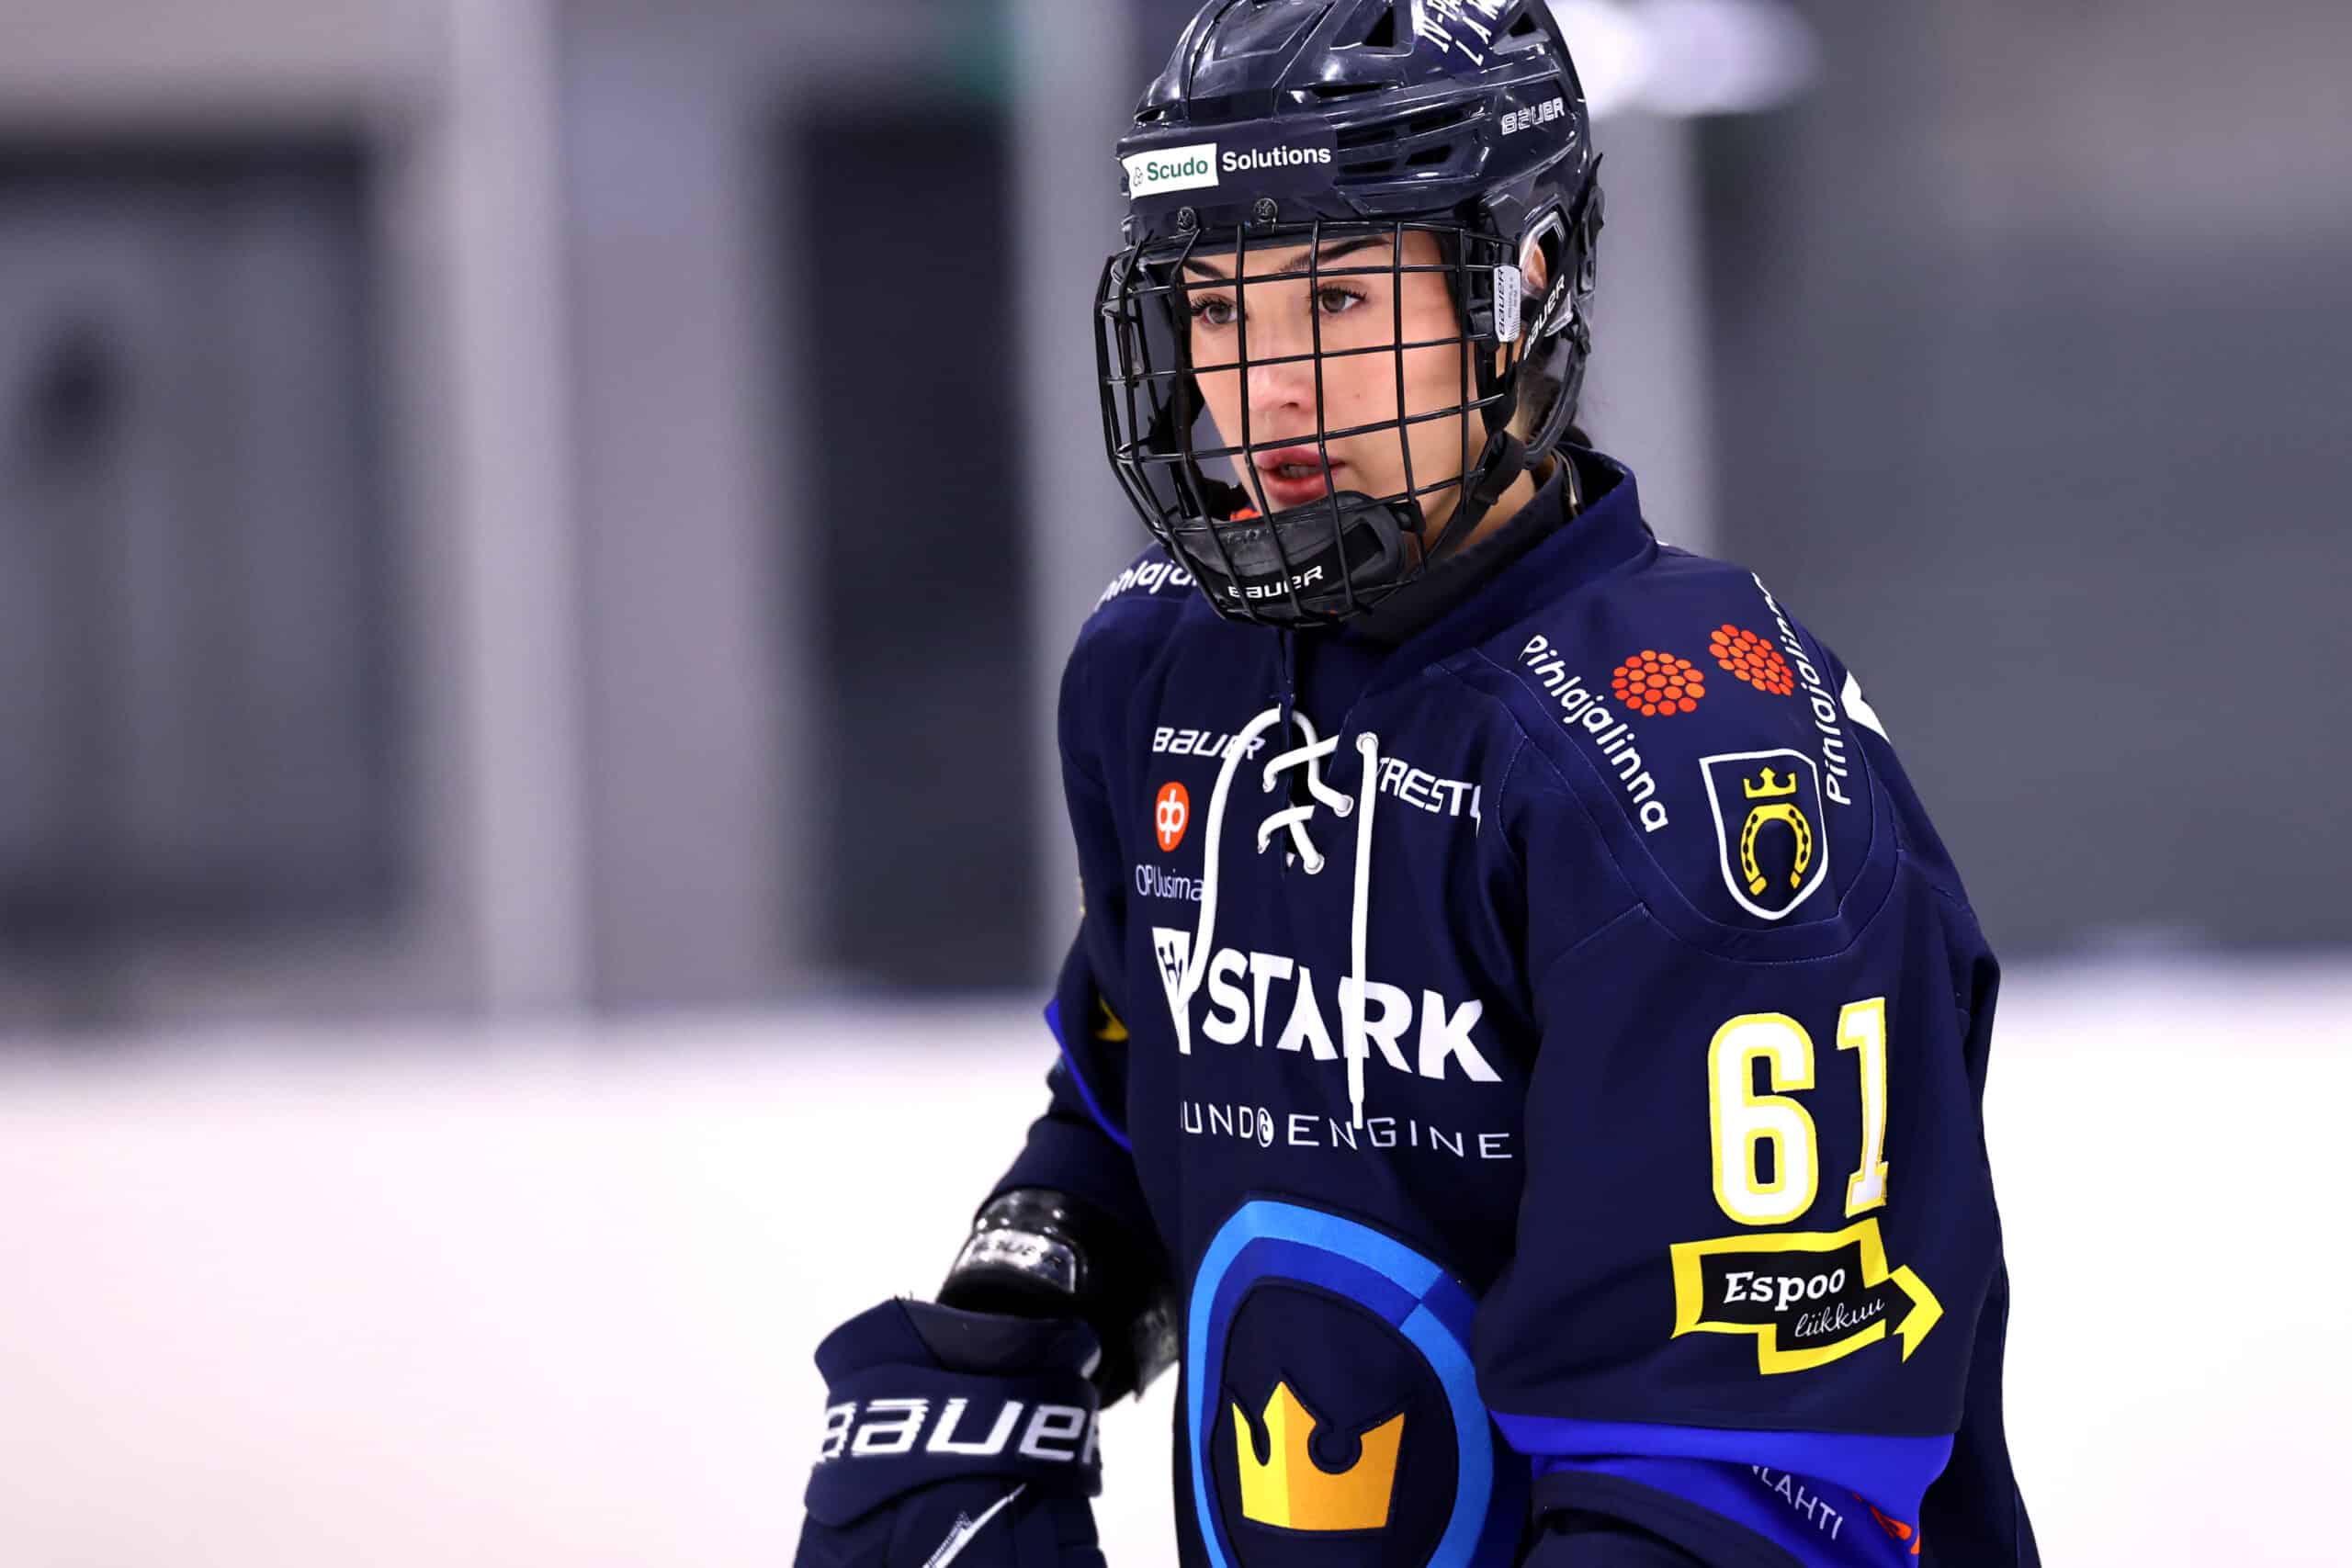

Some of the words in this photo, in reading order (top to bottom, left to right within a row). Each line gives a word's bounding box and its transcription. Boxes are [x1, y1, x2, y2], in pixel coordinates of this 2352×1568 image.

[1147, 159, 1209, 182] Scudo
[1222, 145, 1331, 172] Solutions
[1518, 635, 1668, 832] Pihlajalinna
[1378, 757, 1481, 837] REST
[1202, 947, 1502, 1082] STARK
[1288, 1112, 1512, 1159] ENGINE
[1708, 997, 1889, 1225] 61
[1724, 1269, 1846, 1312] Espoo
[1794, 1298, 1884, 1337] liikkuu
[1752, 1465, 1843, 1540] LAHTI
